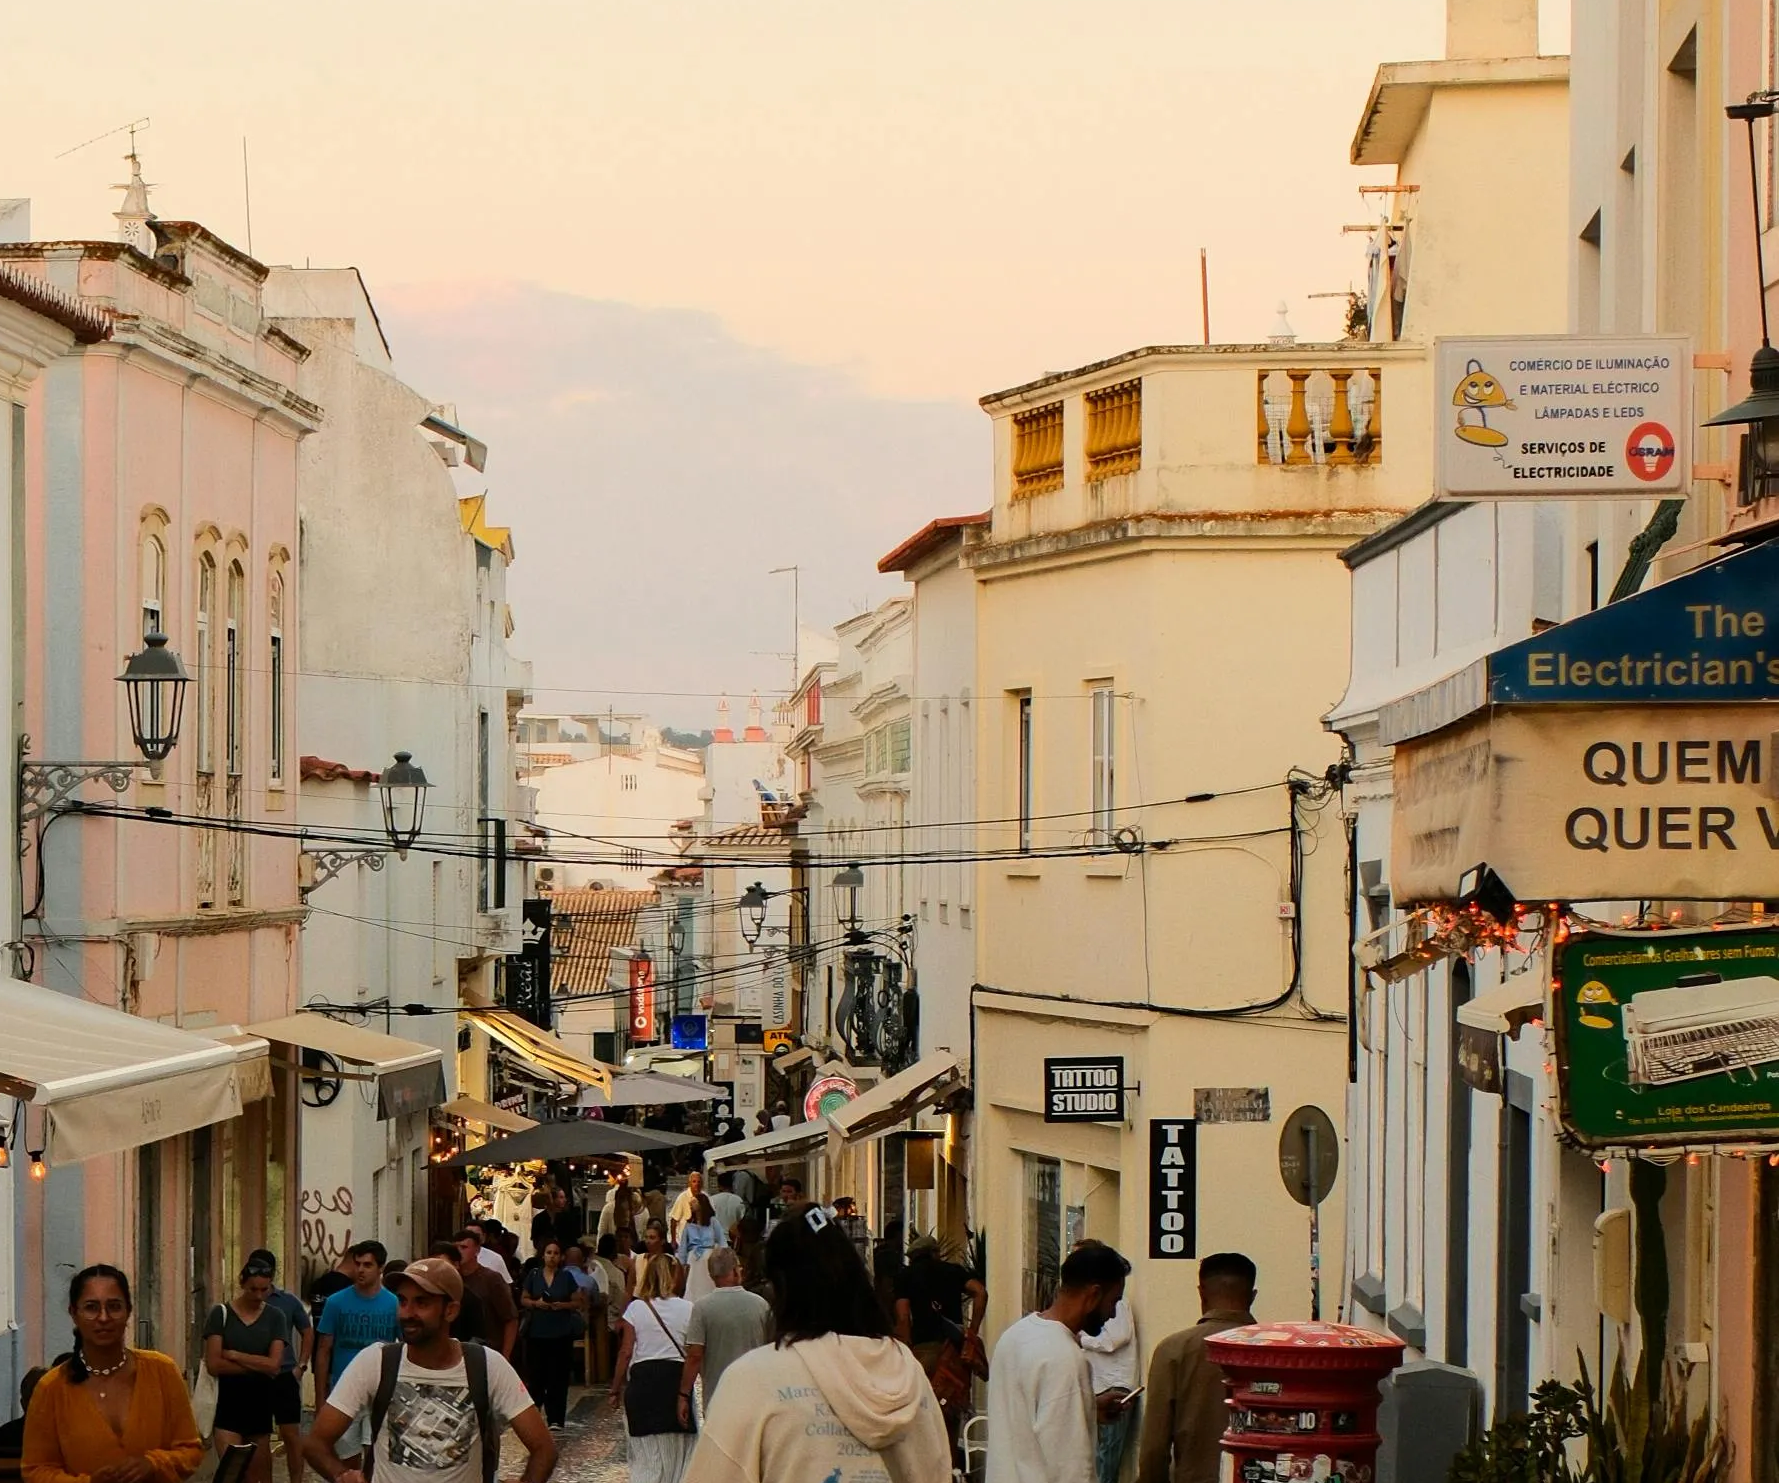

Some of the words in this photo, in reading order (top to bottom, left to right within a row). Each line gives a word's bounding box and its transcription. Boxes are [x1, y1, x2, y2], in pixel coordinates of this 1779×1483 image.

[1509, 358, 1573, 372] COMÉRCIO
[1576, 359, 1592, 370] DE
[1595, 356, 1670, 372] ILUMINAÇÃO
[1520, 384, 1527, 395] E
[1530, 383, 1589, 395] MATERIAL
[1593, 379, 1659, 394] ELÉCTRICO
[1535, 405, 1599, 420] LÂMPADAS
[1602, 407, 1611, 418] E
[1613, 406, 1645, 418] LEDS
[1521, 442, 1585, 457] SERVIÇOS
[1589, 441, 1606, 453] DE
[1513, 465, 1615, 479] ELECTRICIDADE
[1685, 604, 1765, 638] The
[1583, 740, 1761, 787] QUEM
[1565, 806, 1737, 853] QUER
[1722, 948, 1742, 959] sem
[1744, 944, 1775, 957] Fumos
[772, 991, 784, 1025] CASINHA
[1051, 1068, 1118, 1088] TATTOO
[1052, 1093, 1117, 1112] STUDIO
[1657, 1106, 1682, 1117] Loja
[1685, 1104, 1704, 1114] dos
[1708, 1102, 1772, 1113] Candeeiros
[1160, 1124, 1185, 1253] TATTOO
